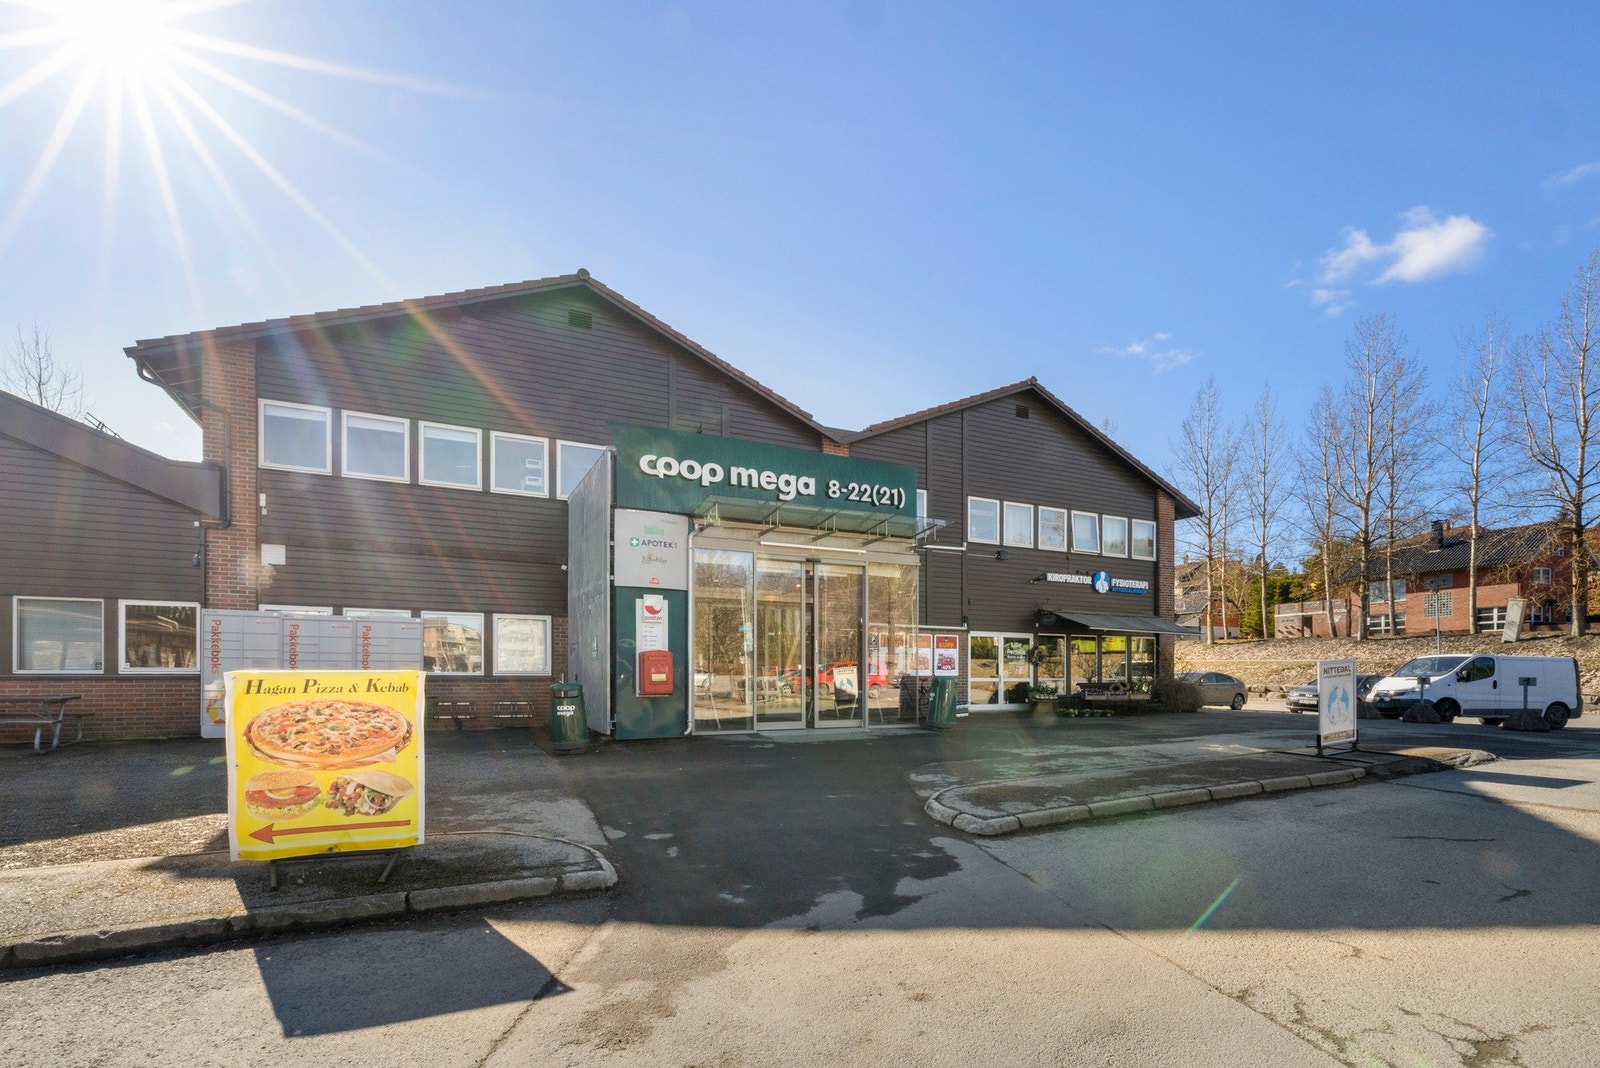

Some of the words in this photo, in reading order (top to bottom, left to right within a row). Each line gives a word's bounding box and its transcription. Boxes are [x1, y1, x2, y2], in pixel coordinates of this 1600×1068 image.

[639, 454, 724, 486] coop
[730, 465, 816, 500] mega
[827, 480, 906, 509] 8-22(21)
[641, 540, 673, 549] APOTEK
[1047, 573, 1092, 585] KIROPRAKTOR
[1111, 578, 1149, 590] FYSIOTERAPI
[211, 619, 222, 675] Pakkeboks
[289, 624, 300, 670] Pakkebok
[362, 625, 372, 670] Pakkebok
[1323, 665, 1352, 675] NITTEDAL
[244, 679, 296, 696] Hagan
[302, 678, 343, 694] Pizza
[348, 683, 359, 693] &
[366, 678, 409, 693] Kebab
